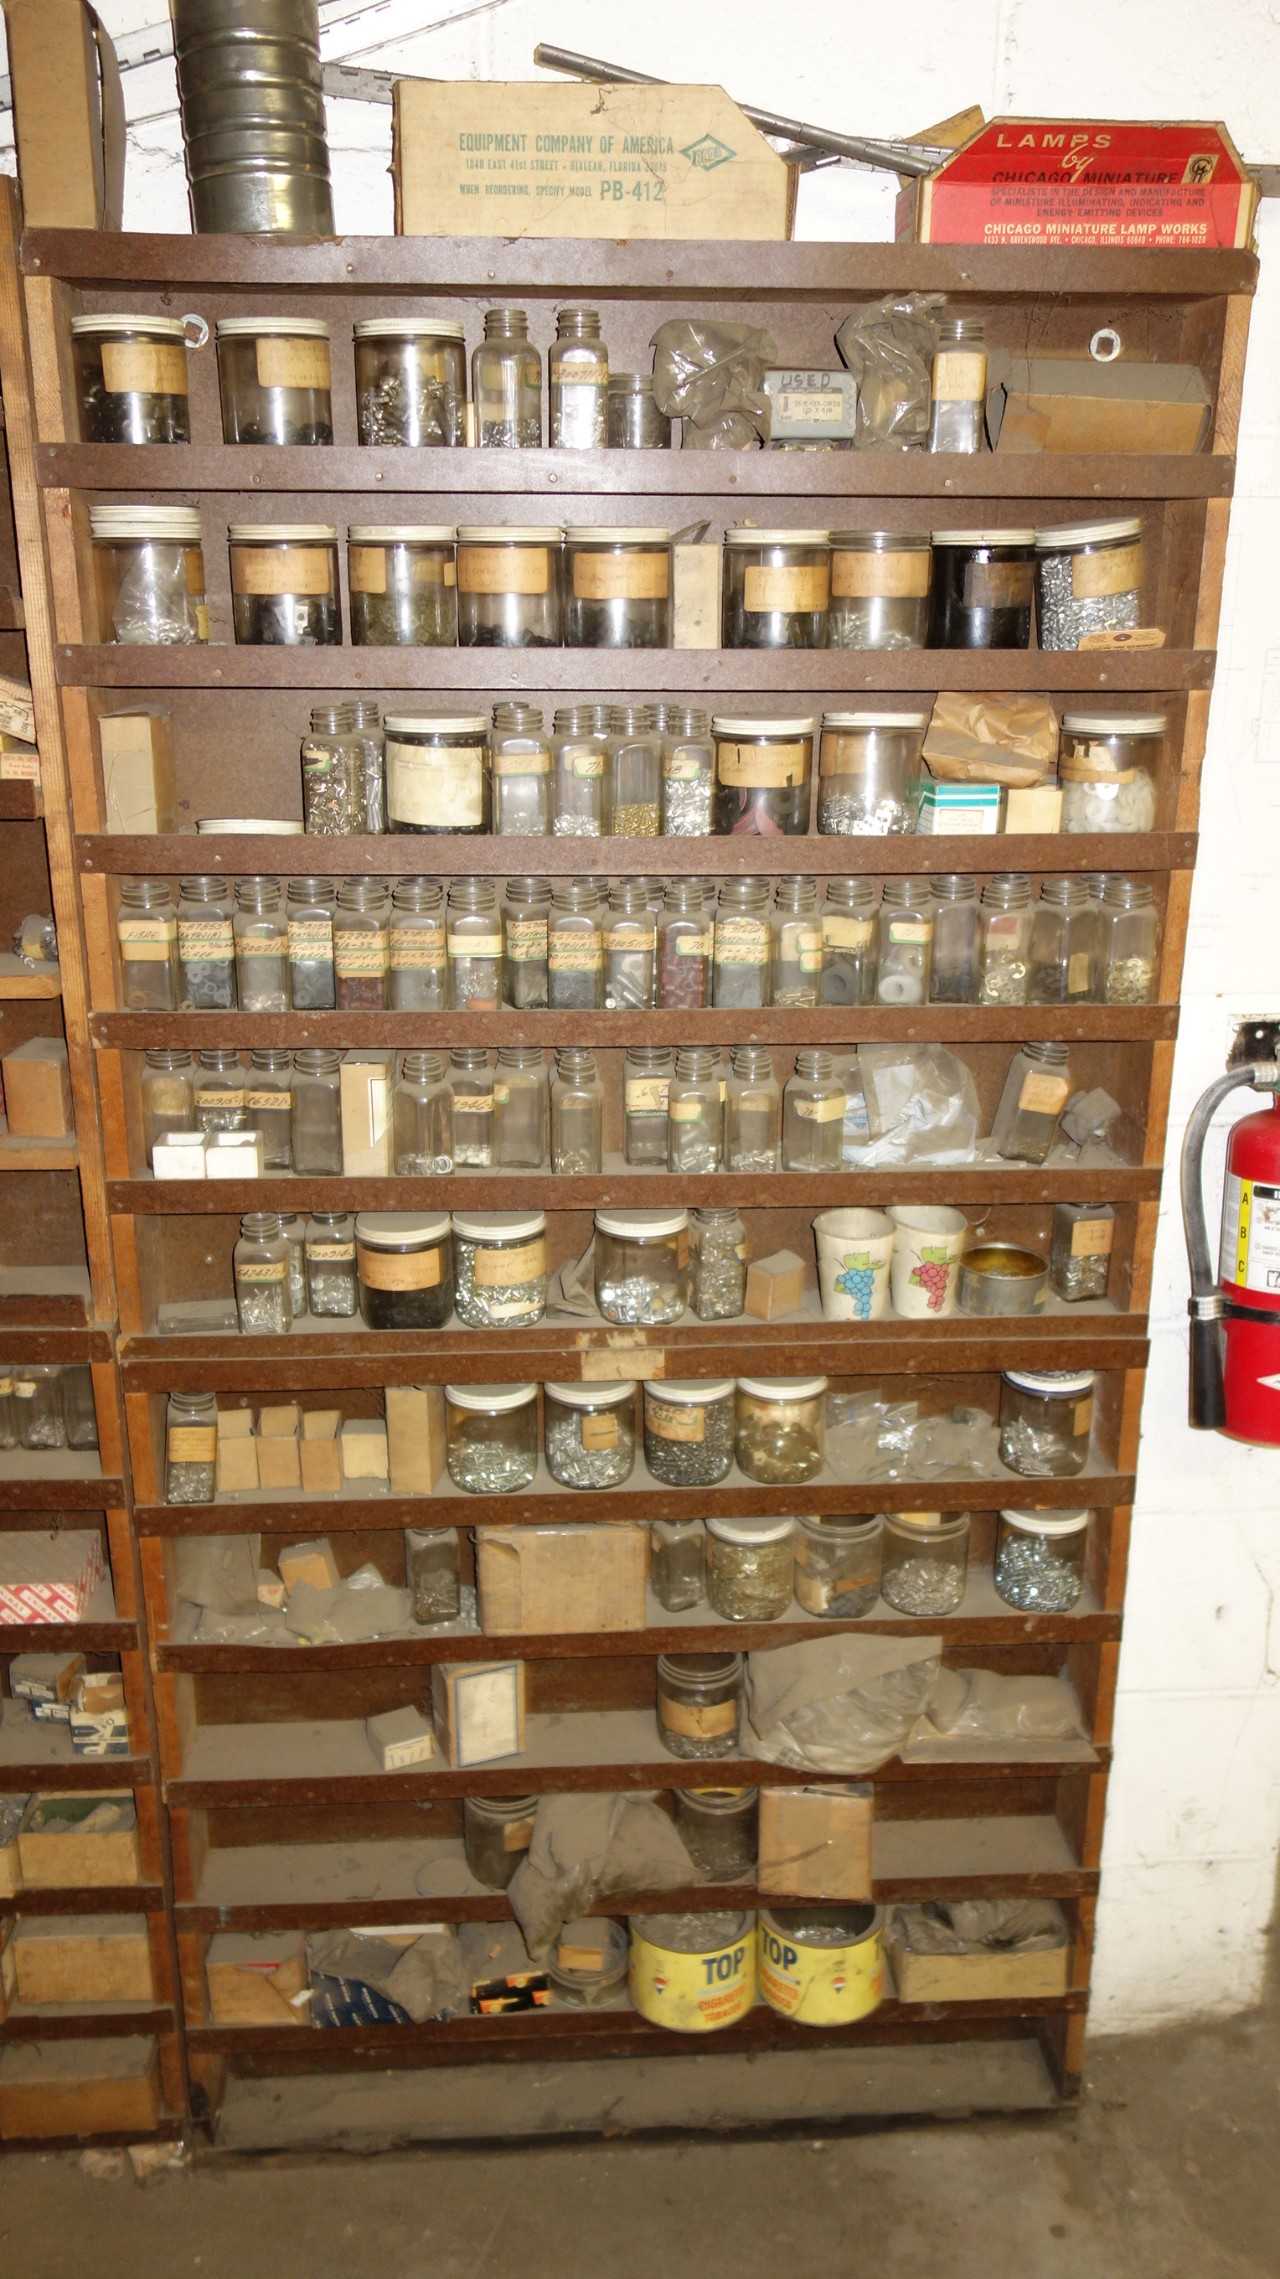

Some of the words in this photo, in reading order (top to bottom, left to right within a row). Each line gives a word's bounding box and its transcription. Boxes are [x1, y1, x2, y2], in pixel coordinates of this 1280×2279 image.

[459, 133, 527, 152] EQUIPMENT
[536, 135, 593, 153] COMPANY
[600, 136, 614, 153] OF
[623, 136, 674, 154] AMERICA
[996, 134, 1112, 148] LAMPS
[488, 159, 506, 170] EAST
[530, 160, 558, 171] STREET
[609, 161, 641, 172] FLORIDA
[1061, 143, 1096, 184] by
[991, 171, 1072, 184] CHICAGO
[1083, 171, 1179, 184] MINIATURE
[459, 184, 480, 195] WHEN
[535, 185, 565, 197] SPECIFY
[569, 185, 593, 197] MODEL
[600, 179, 666, 201] PB-412
[991, 187, 1048, 198] SPECIALISTS
[1063, 188, 1079, 197] THE
[1082, 188, 1116, 197] DESIGN
[1119, 188, 1137, 197] AND
[1139, 188, 1206, 198] MANUFACTURE
[1005, 197, 1057, 207] MINIATURE
[1129, 198, 1189, 207] INDICATING
[1191, 198, 1206, 207] AND
[1077, 208, 1122, 217] EMITTING
[1126, 208, 1164, 217] DEVICES
[983, 223, 1041, 235] CHICAGO
[1045, 223, 1117, 235] MINIATURE
[1120, 223, 1157, 235] LAMP
[1161, 223, 1208, 235] WORKS
[781, 373, 831, 391] USED
[1241, 1192, 1249, 1205] A
[1240, 1226, 1247, 1239] B
[1238, 1261, 1245, 1272] C
[761, 1927, 797, 1970] TOP
[702, 1946, 745, 1985] TOP
